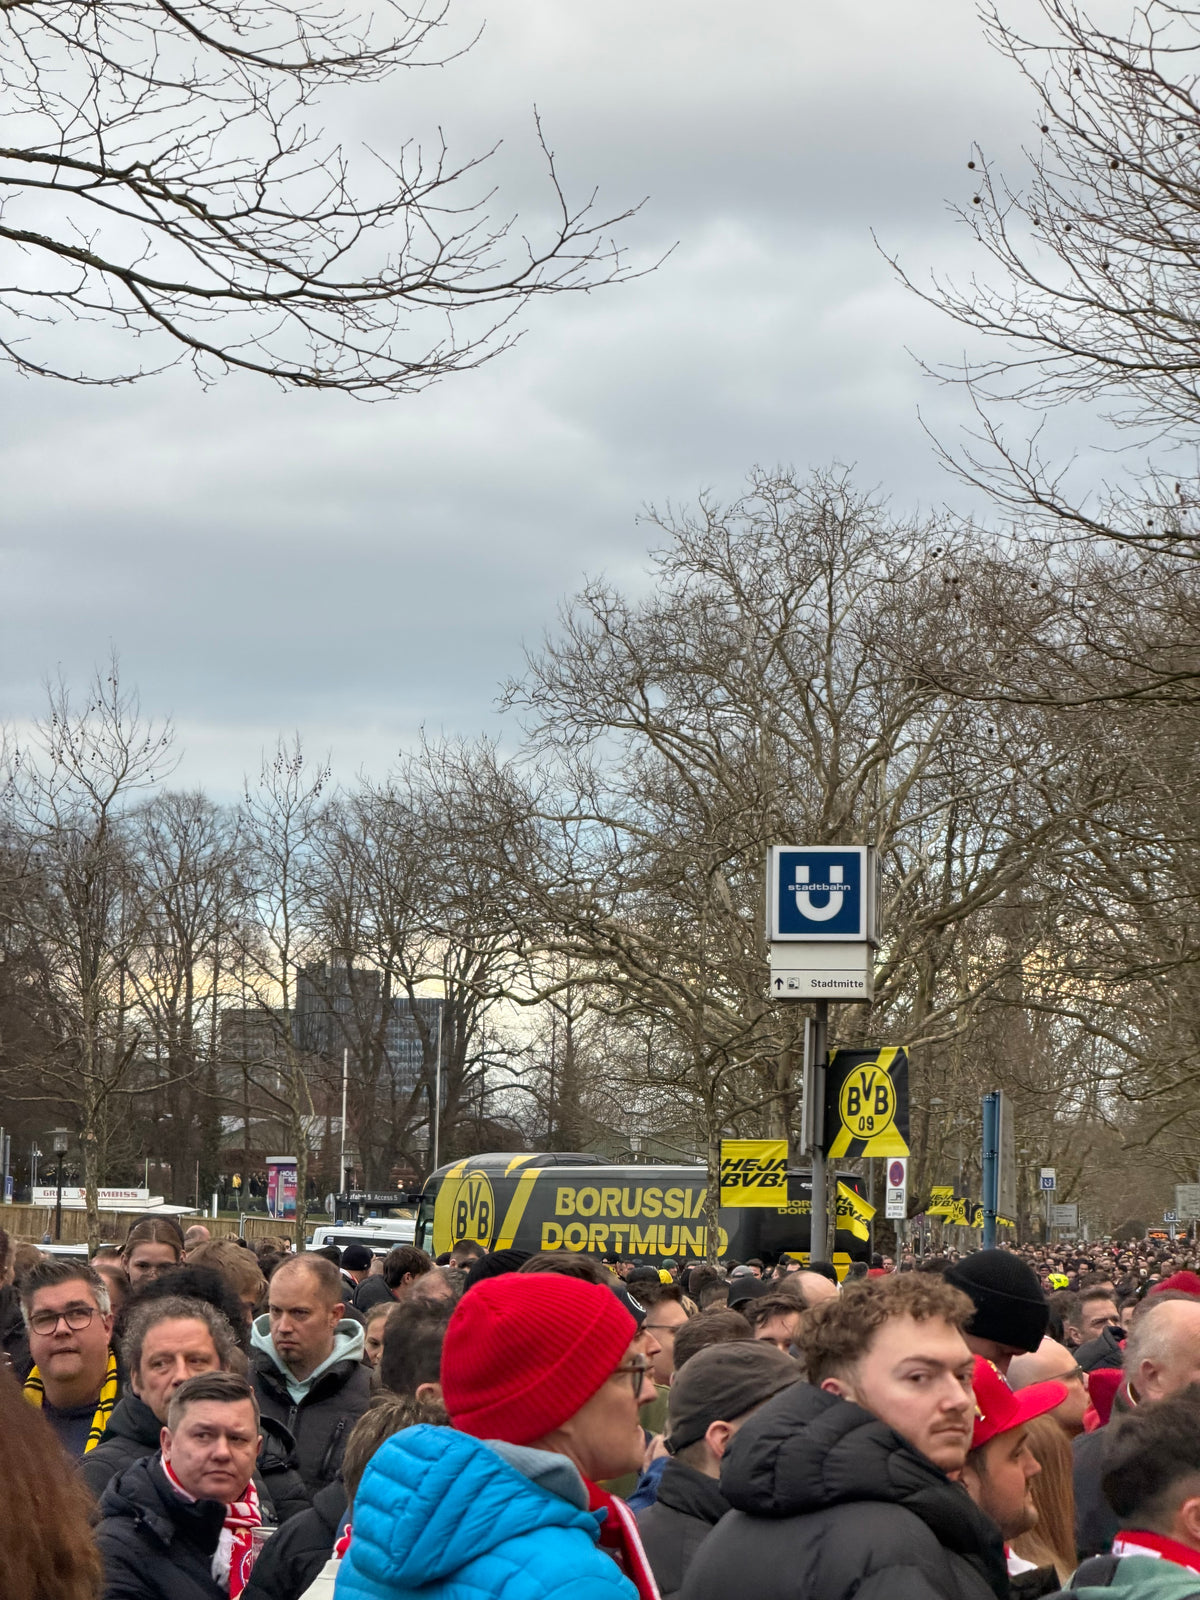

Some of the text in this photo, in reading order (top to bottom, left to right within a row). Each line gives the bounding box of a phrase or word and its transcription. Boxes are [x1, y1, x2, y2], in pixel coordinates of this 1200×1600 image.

[788, 883, 851, 891] stadtbahn
[811, 979, 864, 988] Stadtmitte
[847, 1071, 889, 1116] BVB
[858, 1116, 874, 1131] 09
[721, 1158, 788, 1171] HEJA
[721, 1172, 788, 1187] BVB!
[456, 1181, 489, 1240] BVB
[541, 1222, 729, 1257] DORTMUND
